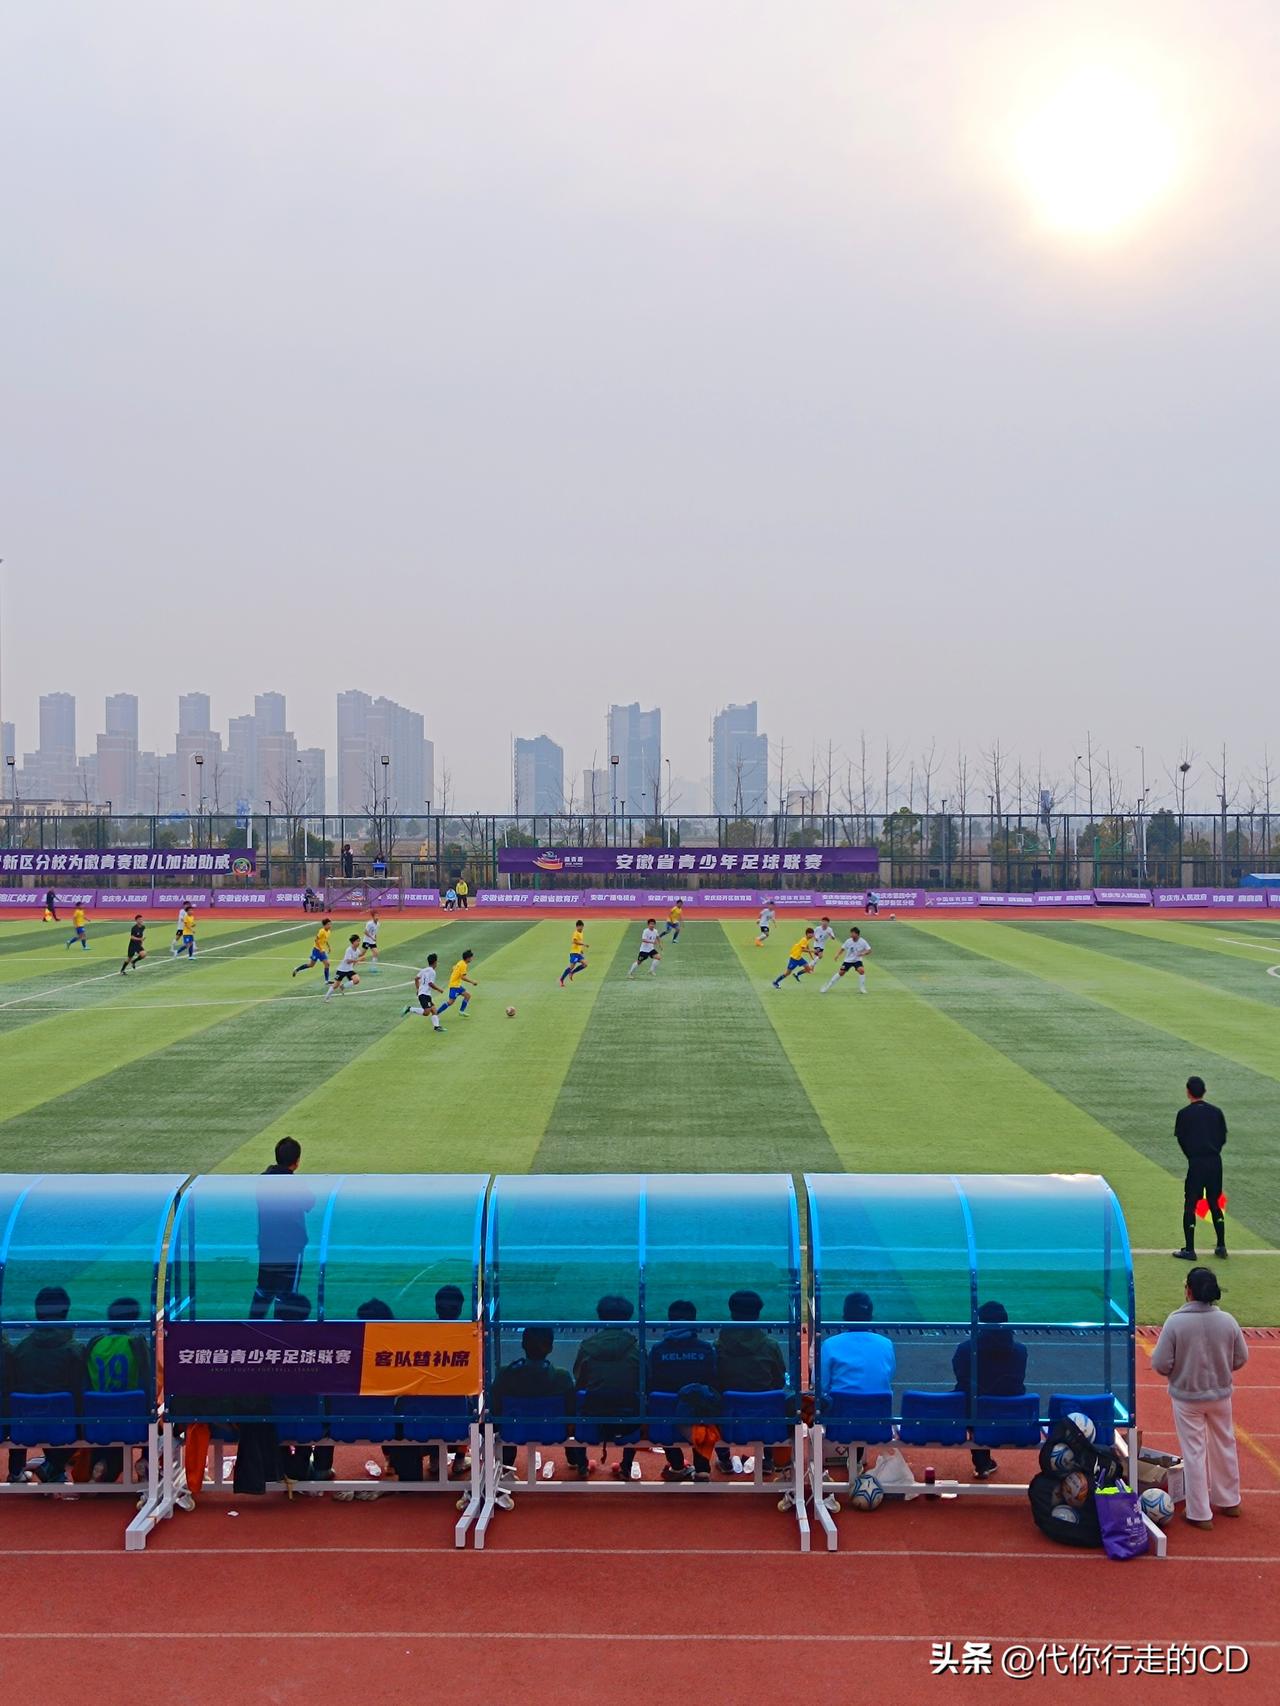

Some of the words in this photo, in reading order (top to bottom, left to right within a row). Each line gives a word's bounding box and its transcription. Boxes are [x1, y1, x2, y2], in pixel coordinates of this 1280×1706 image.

[0, 854, 230, 870] 新区分校为徽青赛健儿加油助威
[616, 854, 823, 870] 安徽省青少年足球联赛
[218, 894, 266, 902] 安徽省体育局
[481, 894, 528, 902] 安徽省教育厅
[533, 894, 579, 902] 安徽省教育厅
[178, 1349, 352, 1364] 安徽省青少年足球联赛
[375, 1350, 471, 1367] 客队替补席
[662, 1352, 697, 1360] KELME
[95, 1353, 129, 1392] 19
